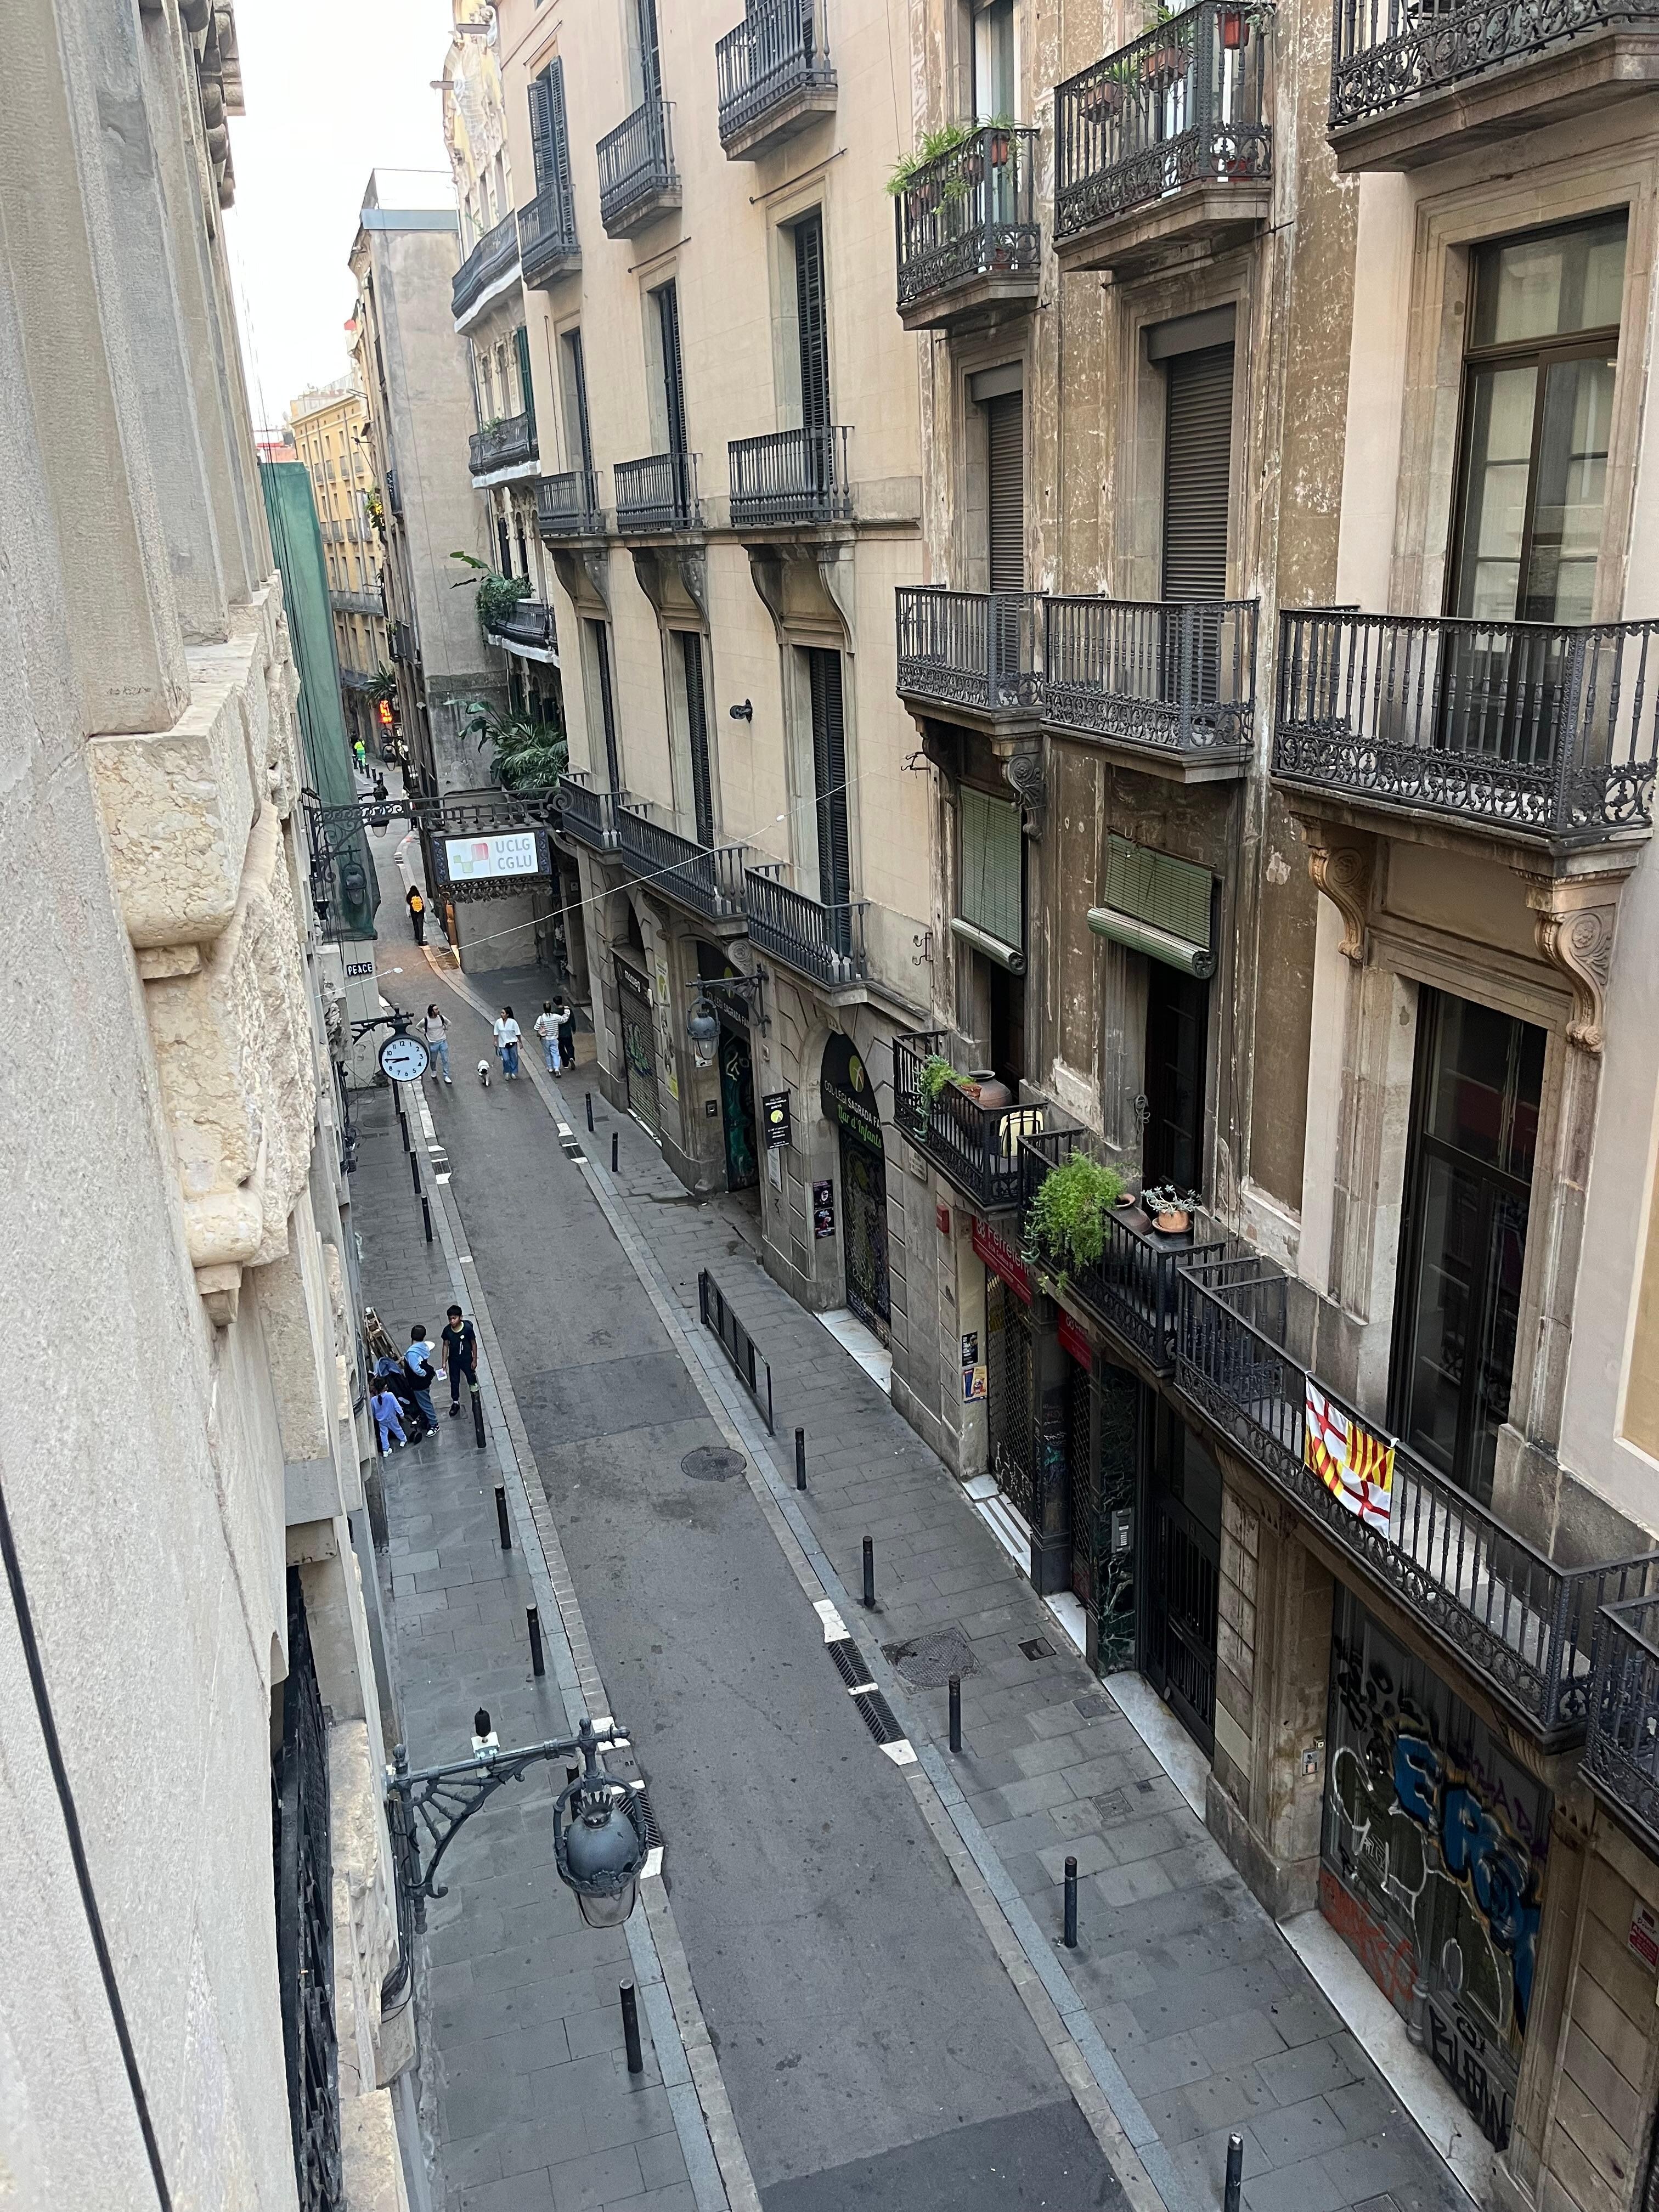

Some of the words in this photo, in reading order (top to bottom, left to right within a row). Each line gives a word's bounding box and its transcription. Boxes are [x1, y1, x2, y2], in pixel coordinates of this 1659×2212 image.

[495, 838, 531, 853] UCLG
[498, 855, 532, 870] CGLU
[348, 963, 373, 976] PEACE
[848, 1097, 873, 1124] SAGRADA
